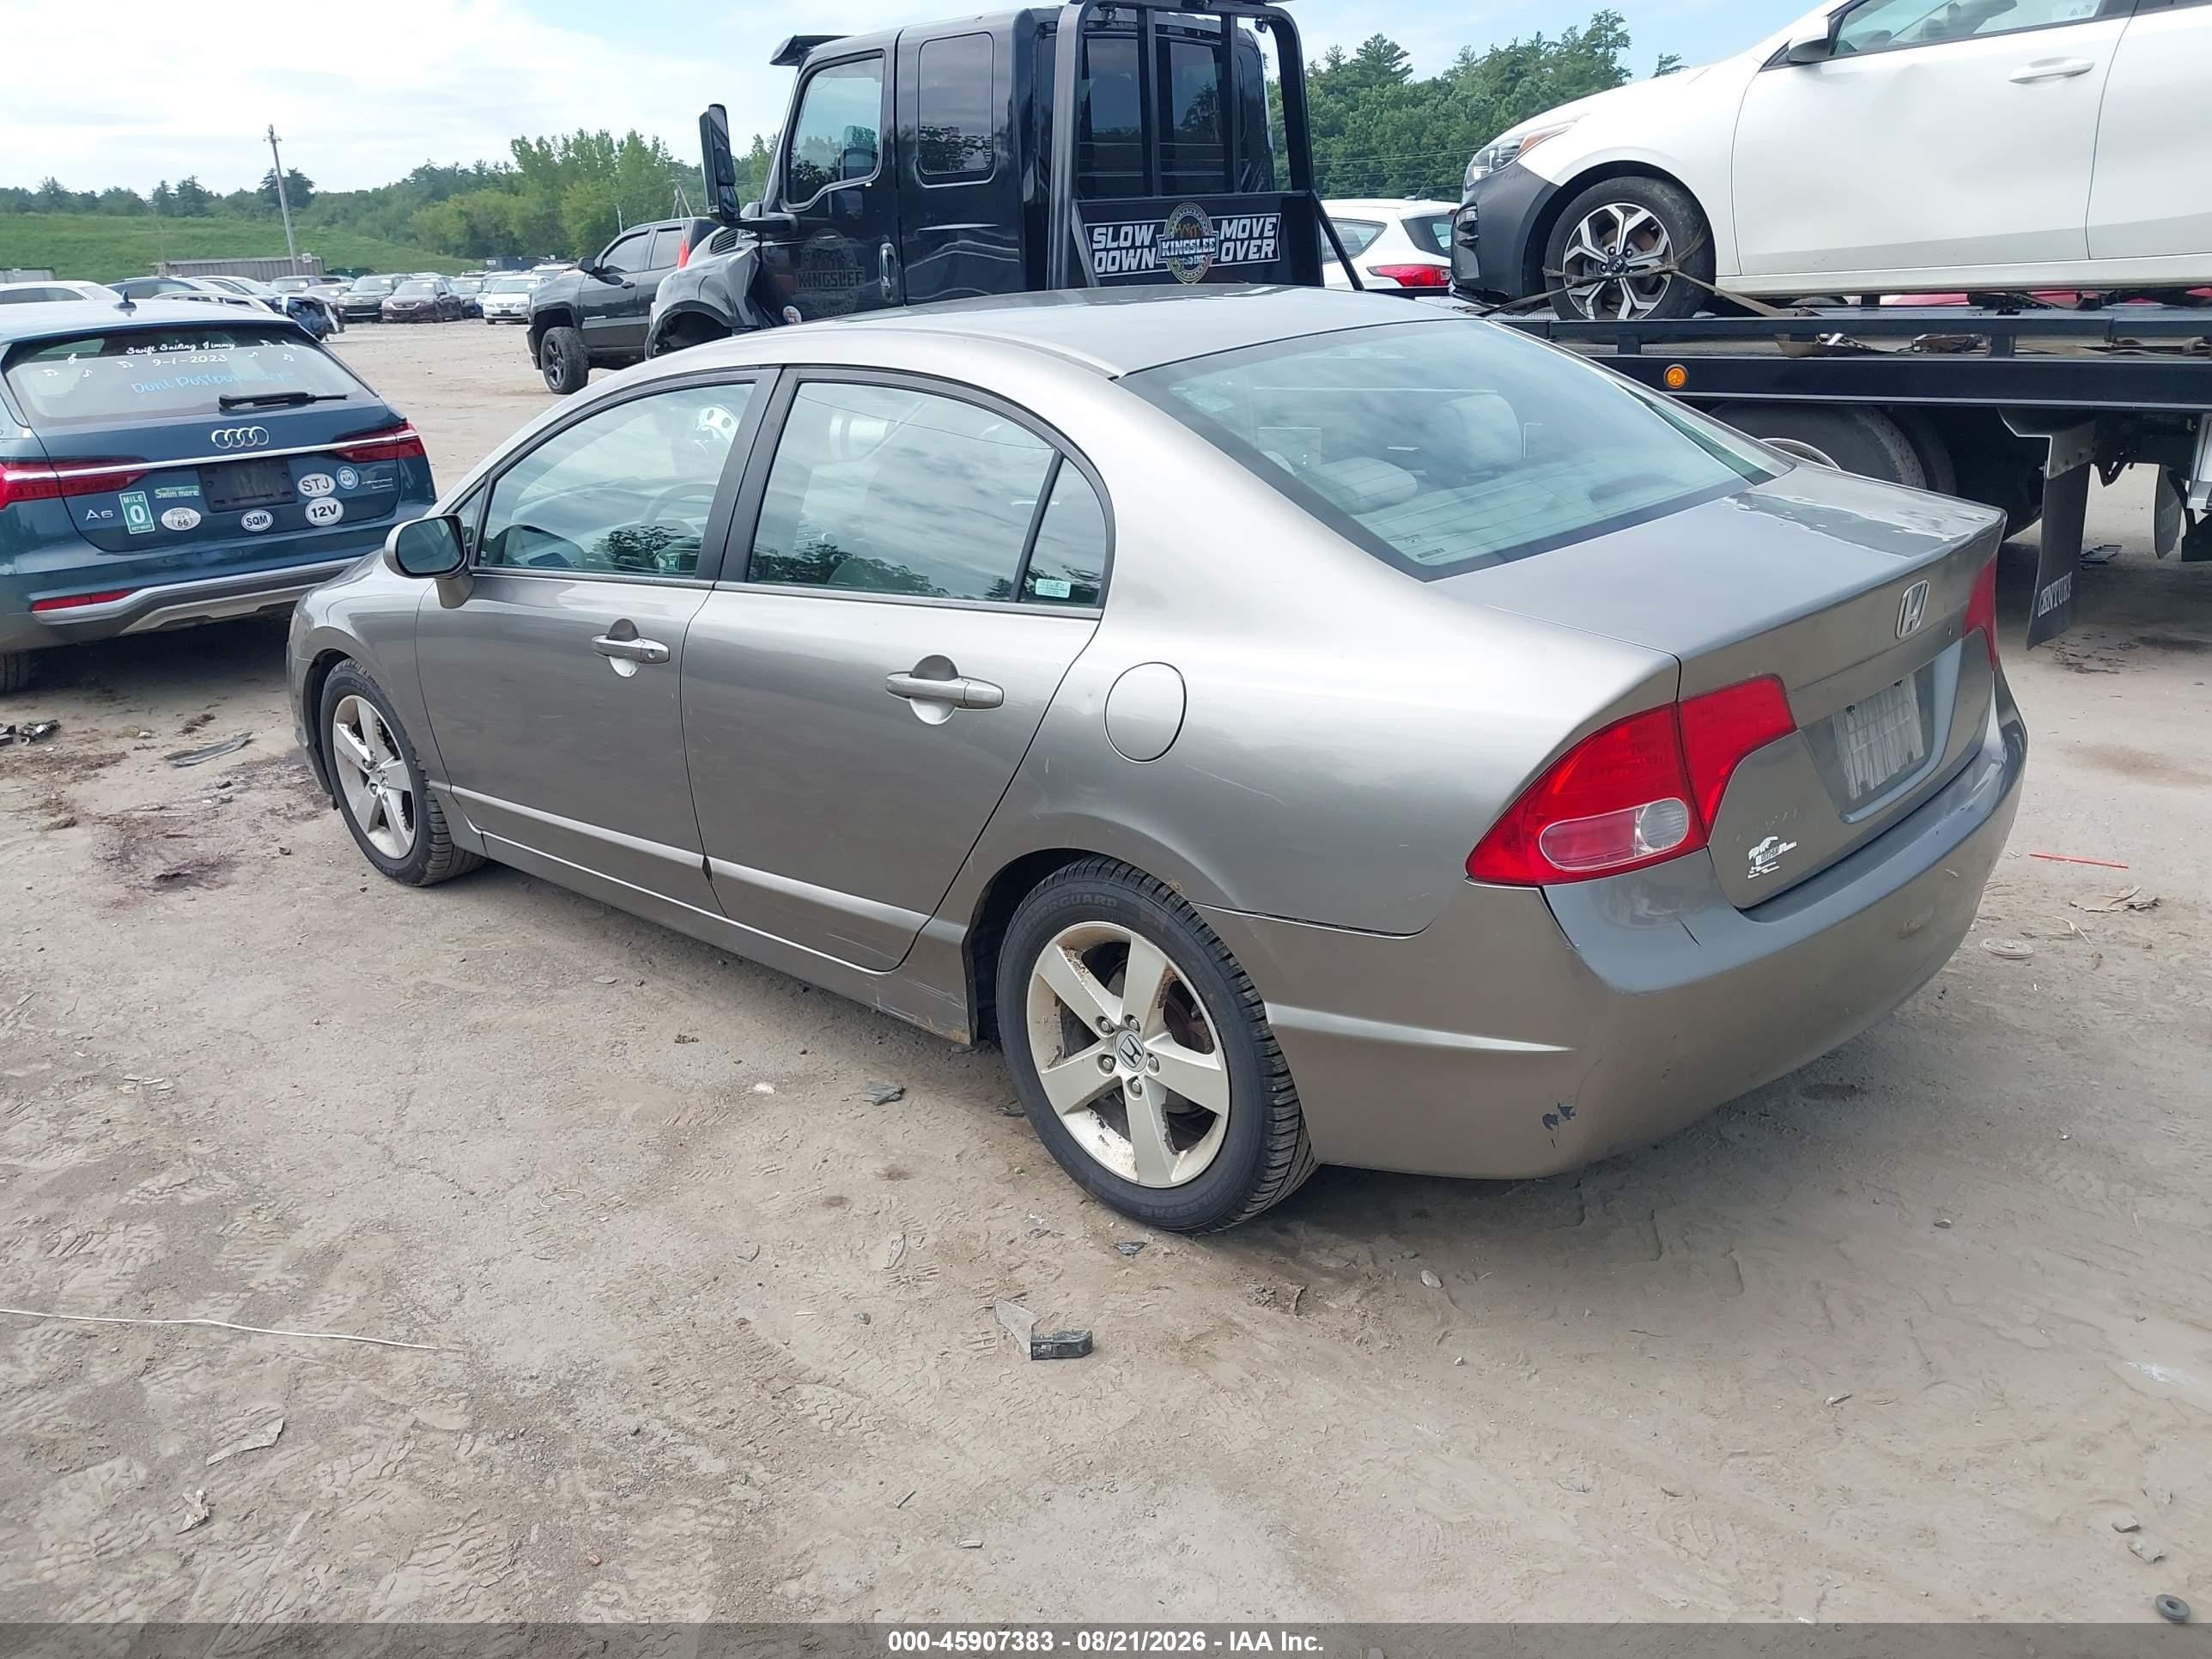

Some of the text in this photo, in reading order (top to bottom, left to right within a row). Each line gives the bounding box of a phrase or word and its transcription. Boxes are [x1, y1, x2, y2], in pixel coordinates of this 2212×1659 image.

[1219, 217, 1277, 240] MOVE
[1092, 225, 1154, 249] SLOW
[1162, 237, 1215, 257] KINGSLEE
[1219, 239, 1276, 262] OVER
[1093, 247, 1157, 273] DOWN
[126, 345, 157, 356] Swift
[203, 341, 235, 350] Jimmy
[152, 354, 228, 367] 9-1-2023
[302, 477, 330, 492] STJ
[123, 494, 144, 504] MILE
[86, 509, 113, 521] A6
[130, 504, 145, 524] 0
[311, 504, 337, 519] 12V
[246, 514, 268, 526] SQM
